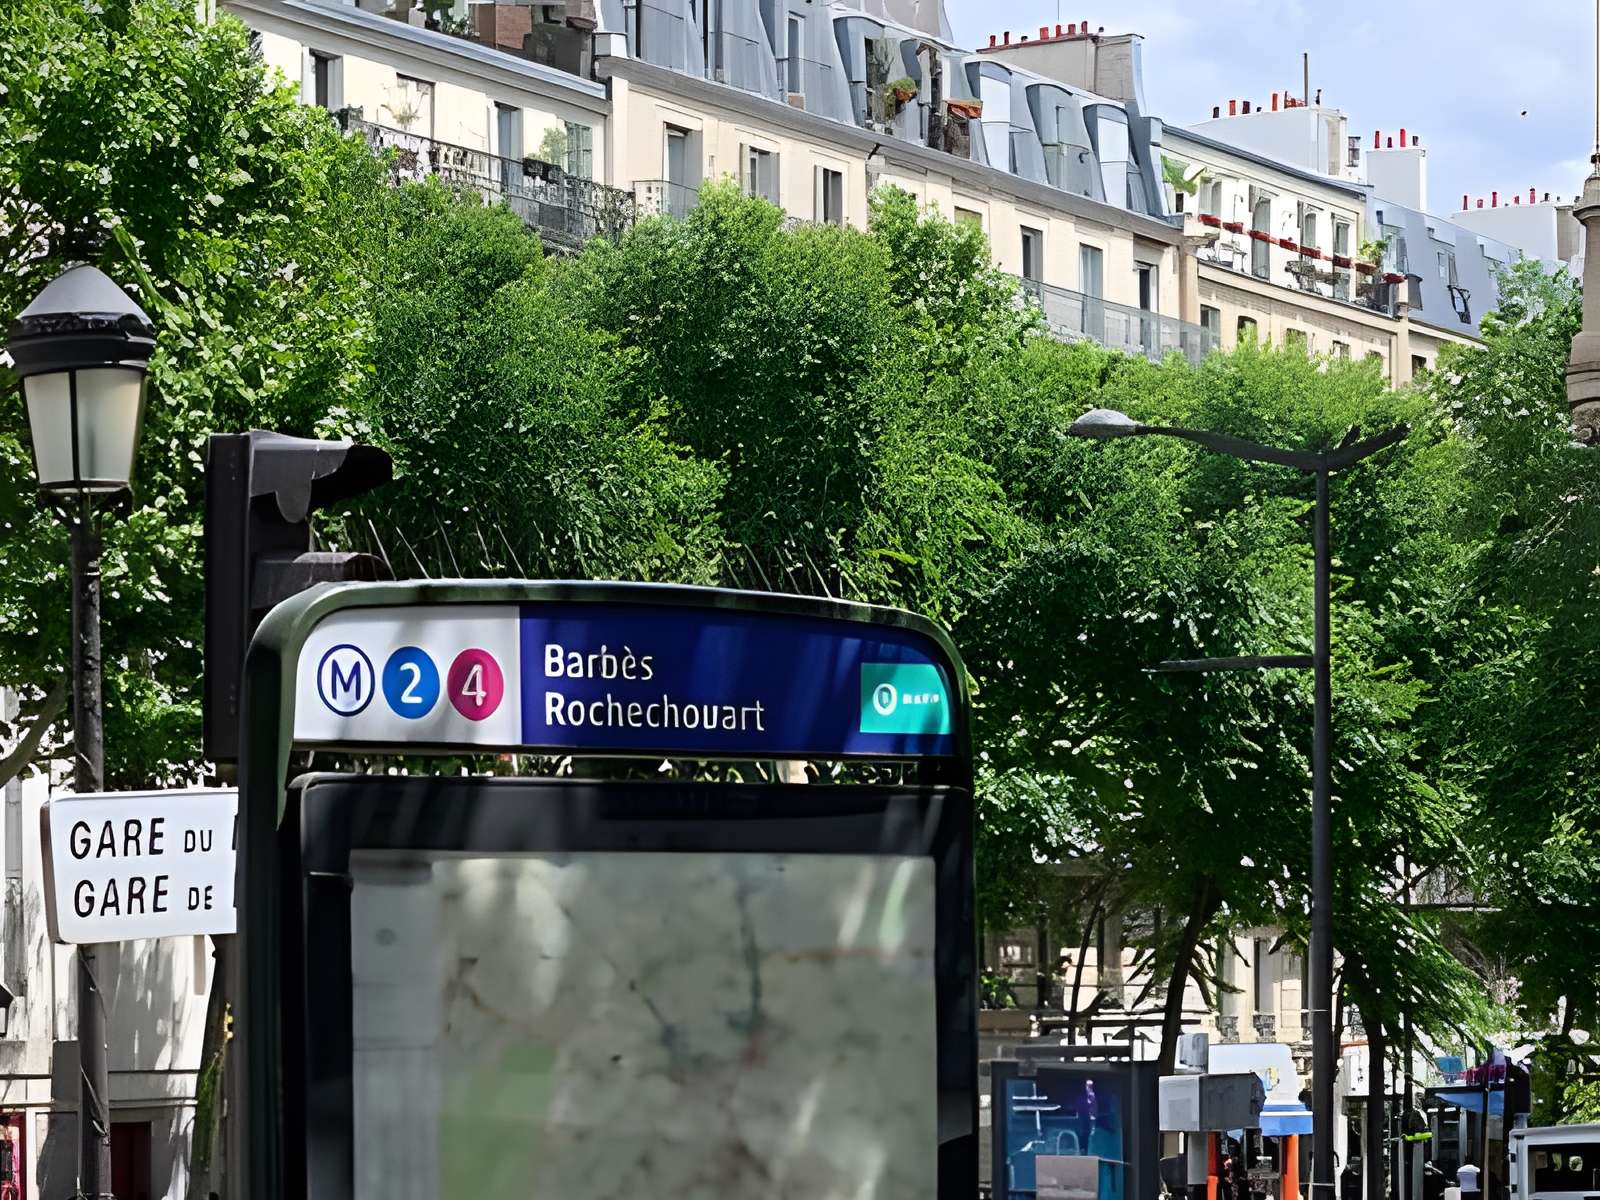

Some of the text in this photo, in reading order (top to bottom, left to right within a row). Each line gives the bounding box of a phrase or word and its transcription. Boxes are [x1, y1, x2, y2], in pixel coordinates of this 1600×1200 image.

[331, 659, 487, 706] M 2 4
[544, 643, 654, 681] Barbès
[544, 691, 765, 732] Rochechouart
[69, 817, 165, 860] GARE
[184, 829, 213, 854] DU
[74, 875, 169, 918] GARE
[188, 885, 213, 911] DE
